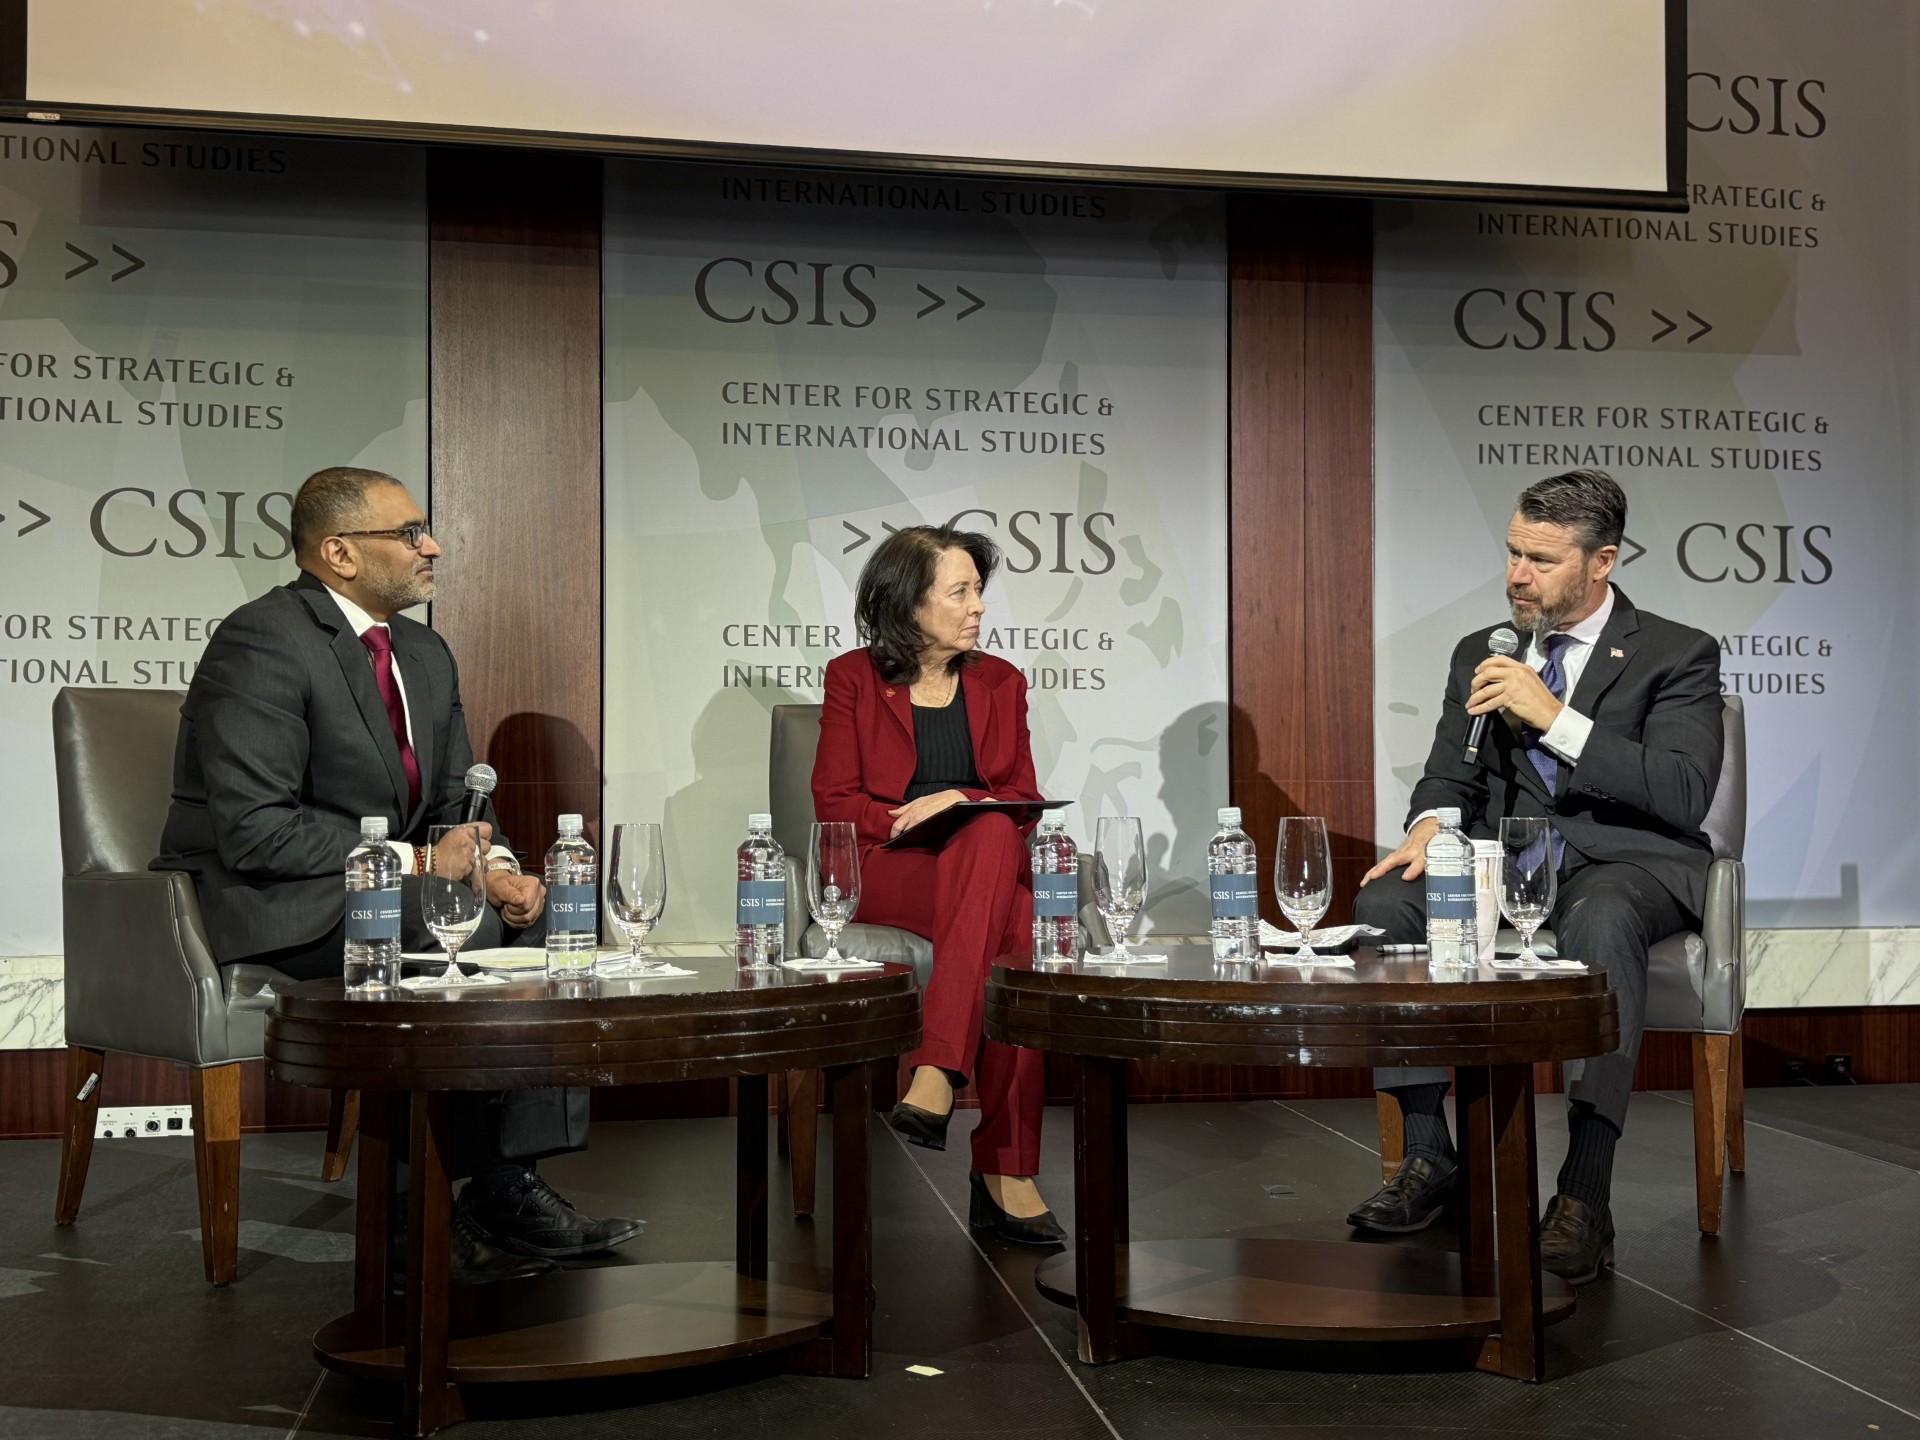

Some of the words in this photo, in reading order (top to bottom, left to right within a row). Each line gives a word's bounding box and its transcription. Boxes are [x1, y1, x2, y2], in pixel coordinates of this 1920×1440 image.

[141, 142, 286, 174] STUDIES
[722, 176, 969, 212] INTERNATIONAL
[981, 187, 1106, 219] STUDIES
[1687, 183, 1803, 211] RATEGIC
[1812, 193, 1826, 212] &
[1478, 213, 1697, 242] INTERNATIONAL
[1708, 221, 1819, 249] STUDIES
[694, 257, 877, 329] CSIS
[1453, 288, 1616, 353] CSIS
[73, 355, 265, 387] STRATEGIC
[275, 367, 296, 388] &
[721, 381, 842, 408] CENTER
[855, 386, 913, 410] FOR
[925, 388, 1089, 416] STRATEGIC
[1097, 397, 1115, 417] &
[137, 400, 284, 430] STUDIES
[1477, 404, 1585, 428] CENTER
[1597, 406, 1649, 429] FOR
[1660, 407, 1806, 434] STRATEGIC
[1814, 416, 1829, 435] &
[722, 422, 969, 452] INTERNATIONAL
[981, 429, 1105, 456] STUDIES
[1478, 443, 1700, 468] INTERNATIONAL
[1710, 447, 1822, 472] STUDIES
[89, 487, 296, 561] CSIS
[1676, 522, 1833, 585] CSIS
[0, 614, 52, 640] OR
[722, 624, 842, 648] CENTER
[974, 627, 1089, 651] ATEGIC
[1097, 631, 1115, 651] &
[1817, 639, 1833, 657] &
[0, 658, 118, 684] IONAL
[1719, 672, 1826, 695] STUDIES
[553, 903, 574, 912] CSIS
[740, 898, 760, 907] CSIS
[1034, 890, 1050, 899] CSIS
[1213, 891, 1230, 900] CSIS
[1427, 892, 1442, 902] CSIS
[351, 909, 373, 920] CSIS
